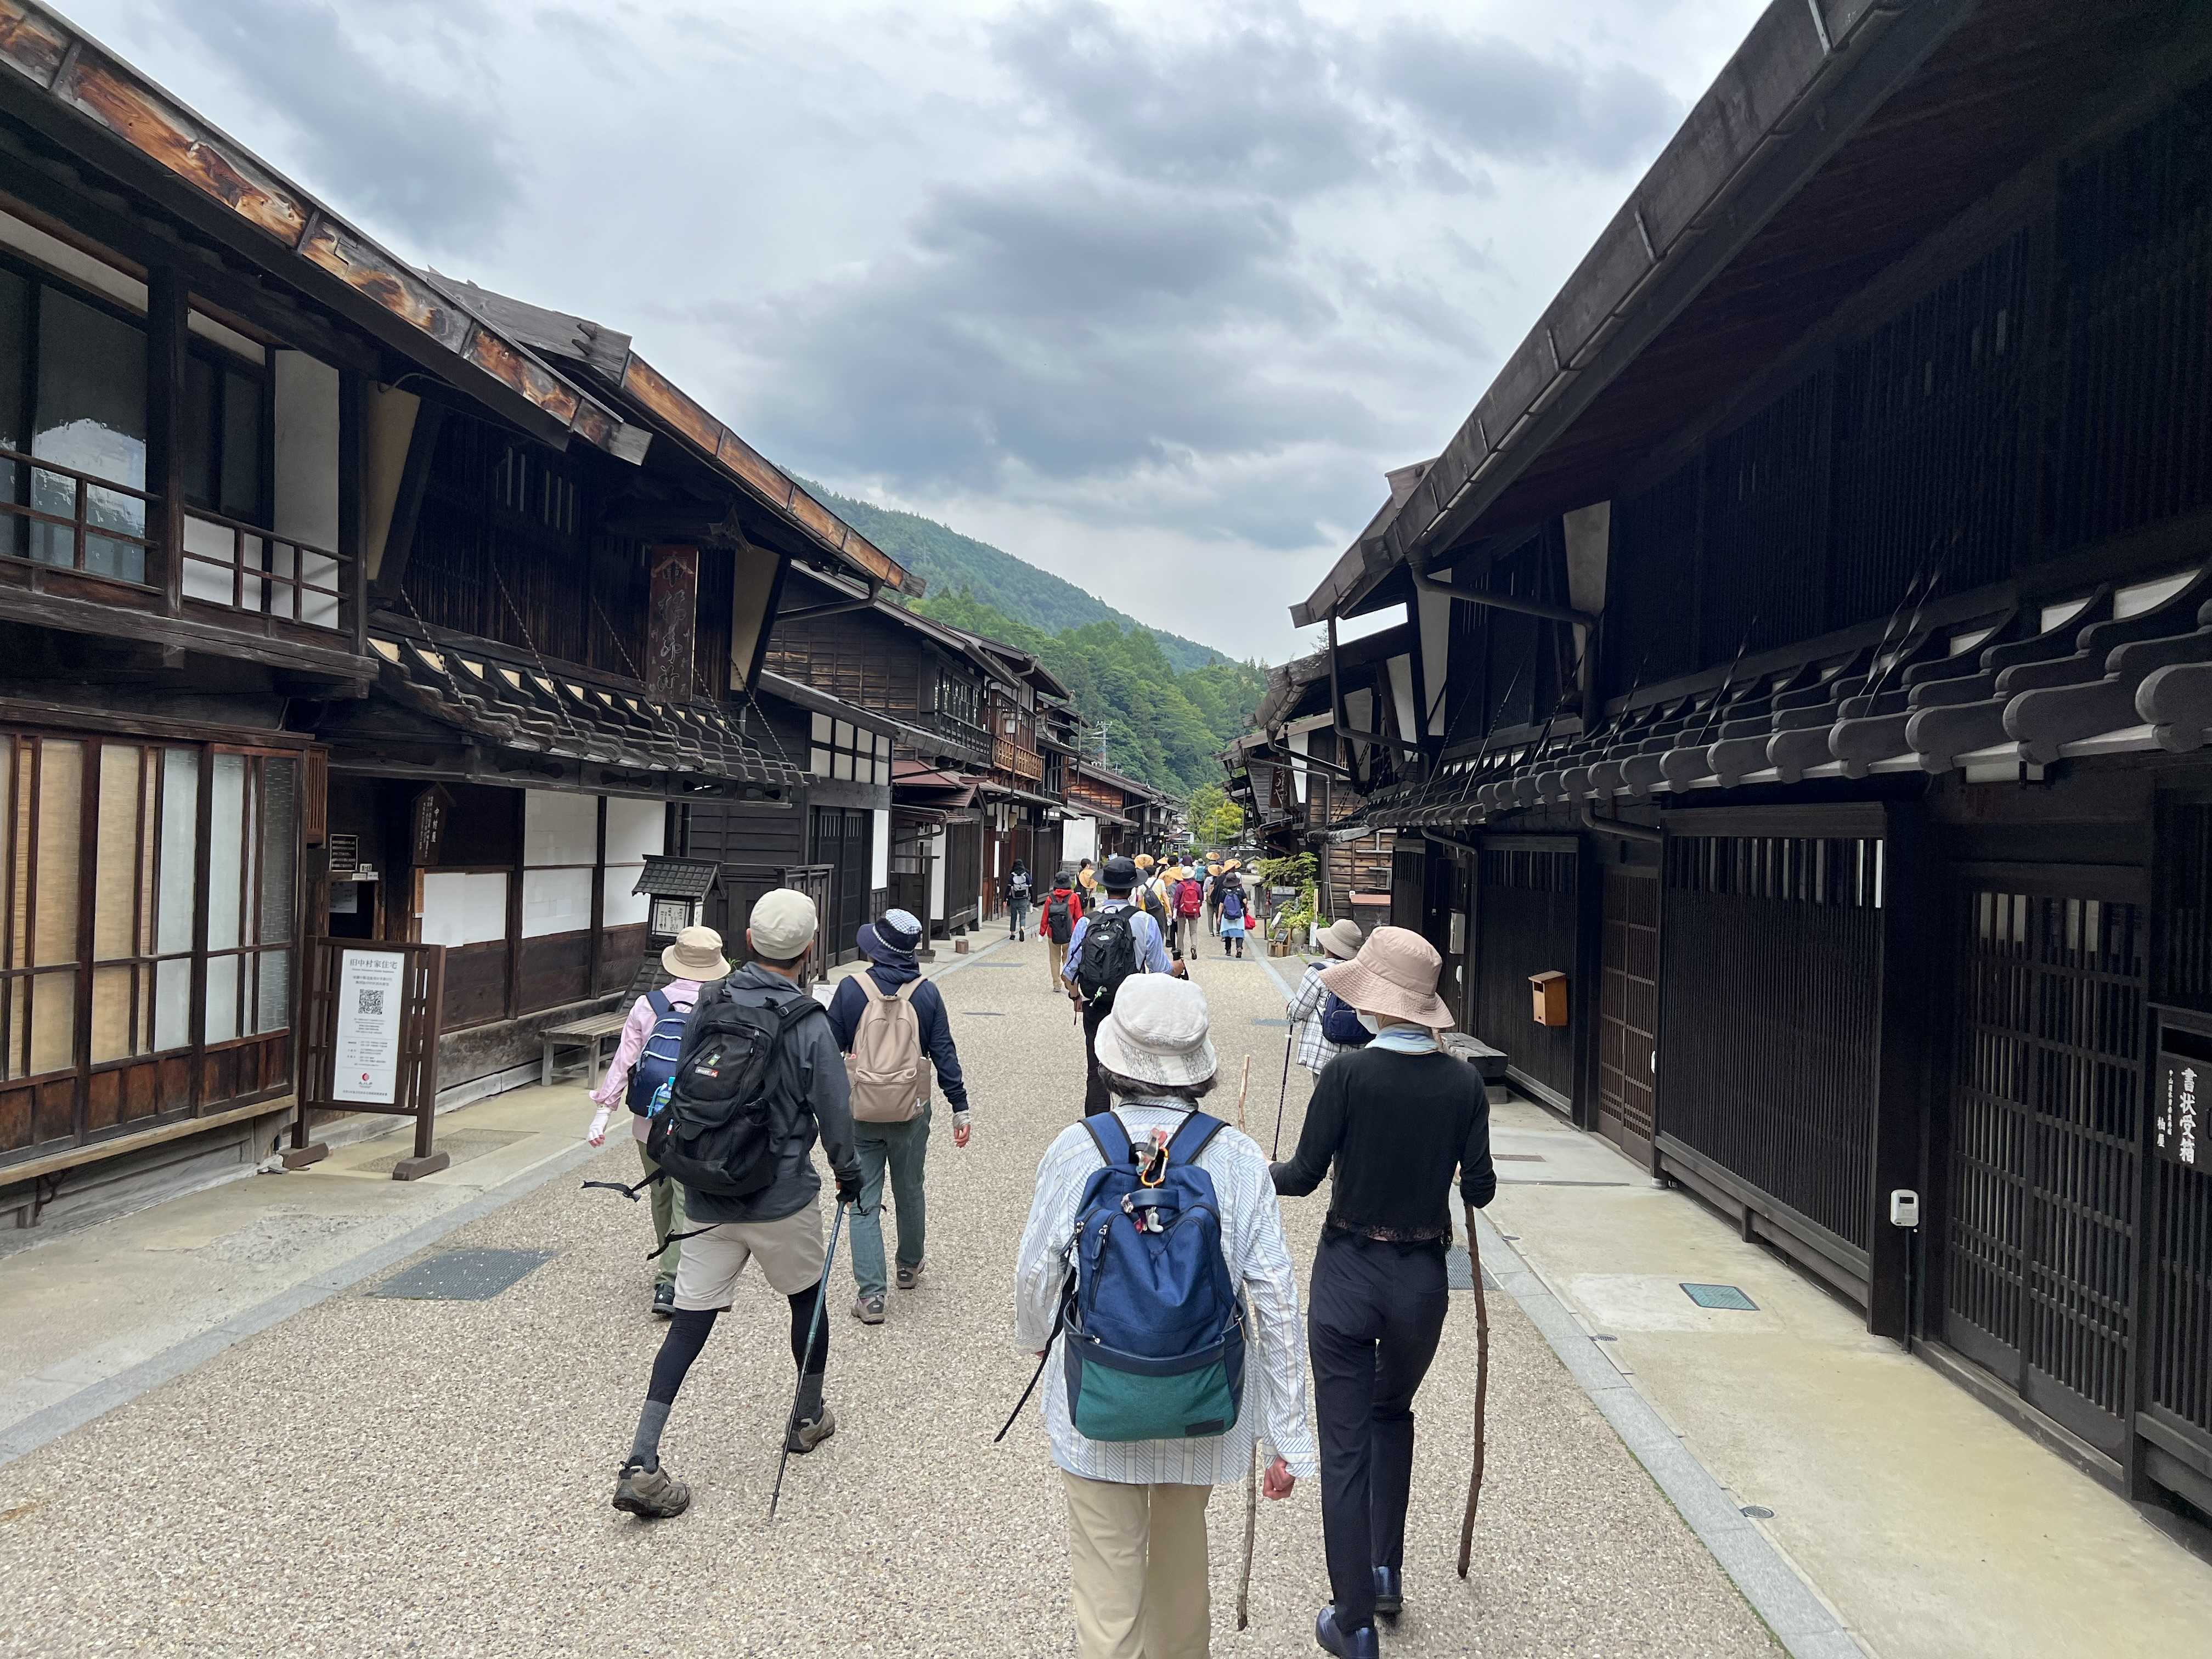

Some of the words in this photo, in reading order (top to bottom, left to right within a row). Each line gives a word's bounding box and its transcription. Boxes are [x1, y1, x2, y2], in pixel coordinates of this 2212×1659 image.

[350, 959, 398, 969] 旧中村家住宅
